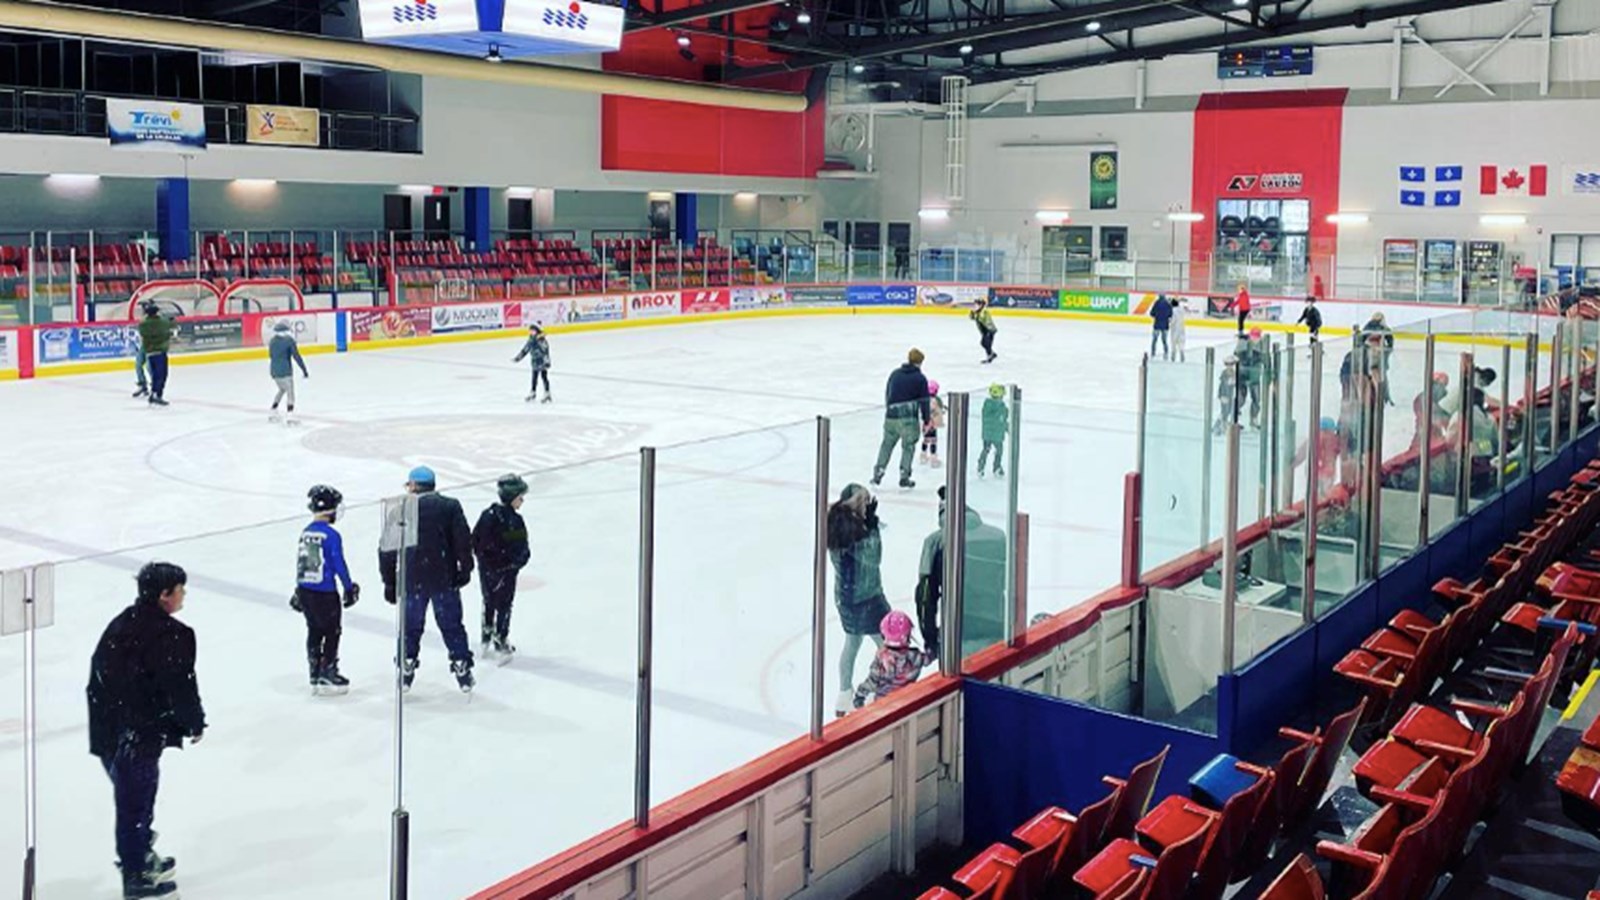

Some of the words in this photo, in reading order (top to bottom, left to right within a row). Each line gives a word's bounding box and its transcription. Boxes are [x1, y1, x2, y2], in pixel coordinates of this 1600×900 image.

[1261, 180, 1302, 188] LAUZON
[642, 295, 676, 307] ROY
[1063, 295, 1126, 309] SUBWAY
[452, 307, 499, 321] MOQUIN
[78, 326, 142, 350] Prestig
